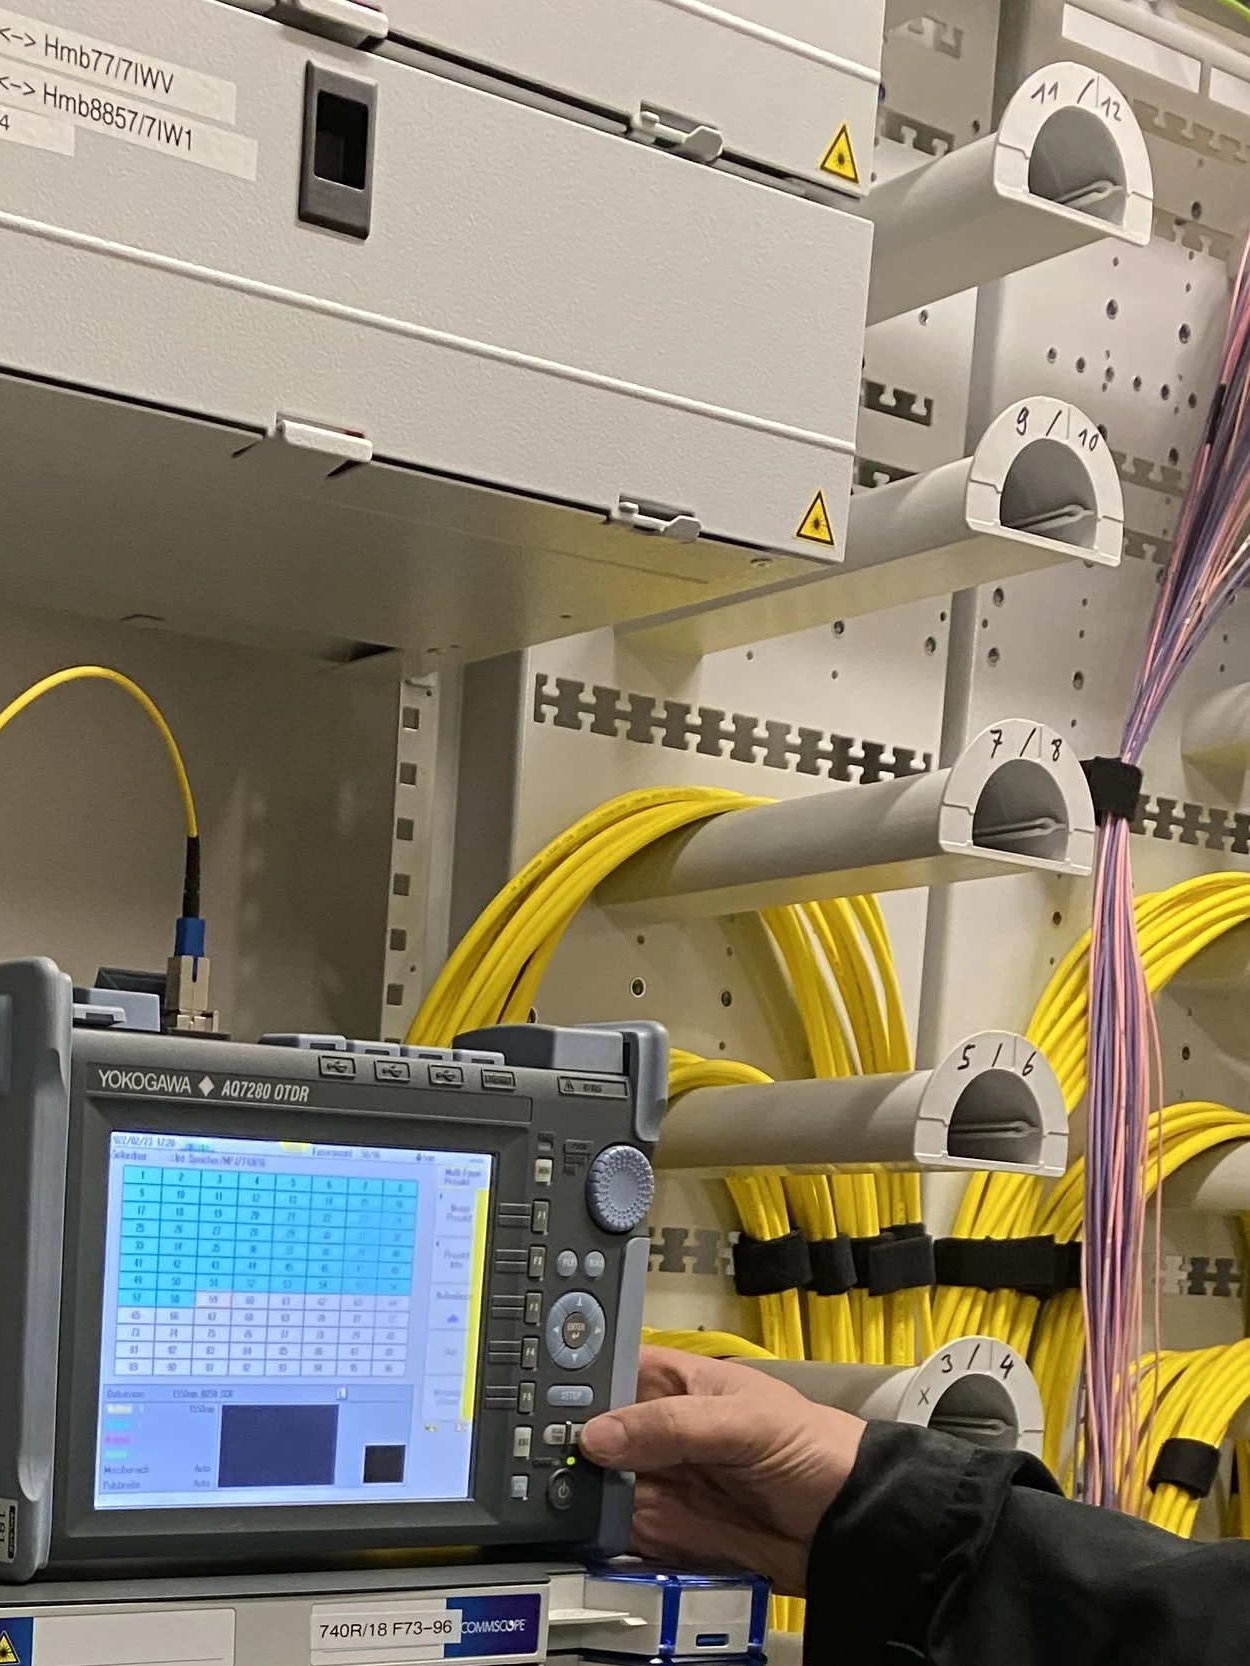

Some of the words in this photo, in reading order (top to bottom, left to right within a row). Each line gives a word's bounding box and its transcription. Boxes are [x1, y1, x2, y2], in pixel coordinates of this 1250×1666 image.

[44, 34, 174, 94] Hmb77/7IWV
[43, 82, 192, 151] Hmb8857/7IW1
[98, 1069, 191, 1094] YOKOGAWA
[221, 1080, 271, 1100] AQ7280
[274, 1084, 309, 1102] OTDR
[537, 1211, 546, 1220] F1
[533, 1256, 543, 1265] F2
[529, 1302, 539, 1311] F3
[567, 1322, 585, 1331] ENTER
[526, 1347, 535, 1356] F4
[522, 1392, 531, 1401] F5
[319, 1622, 388, 1639] 740R/18
[392, 1619, 453, 1636] F73-96
[461, 1618, 526, 1634] COMMSCOPE
